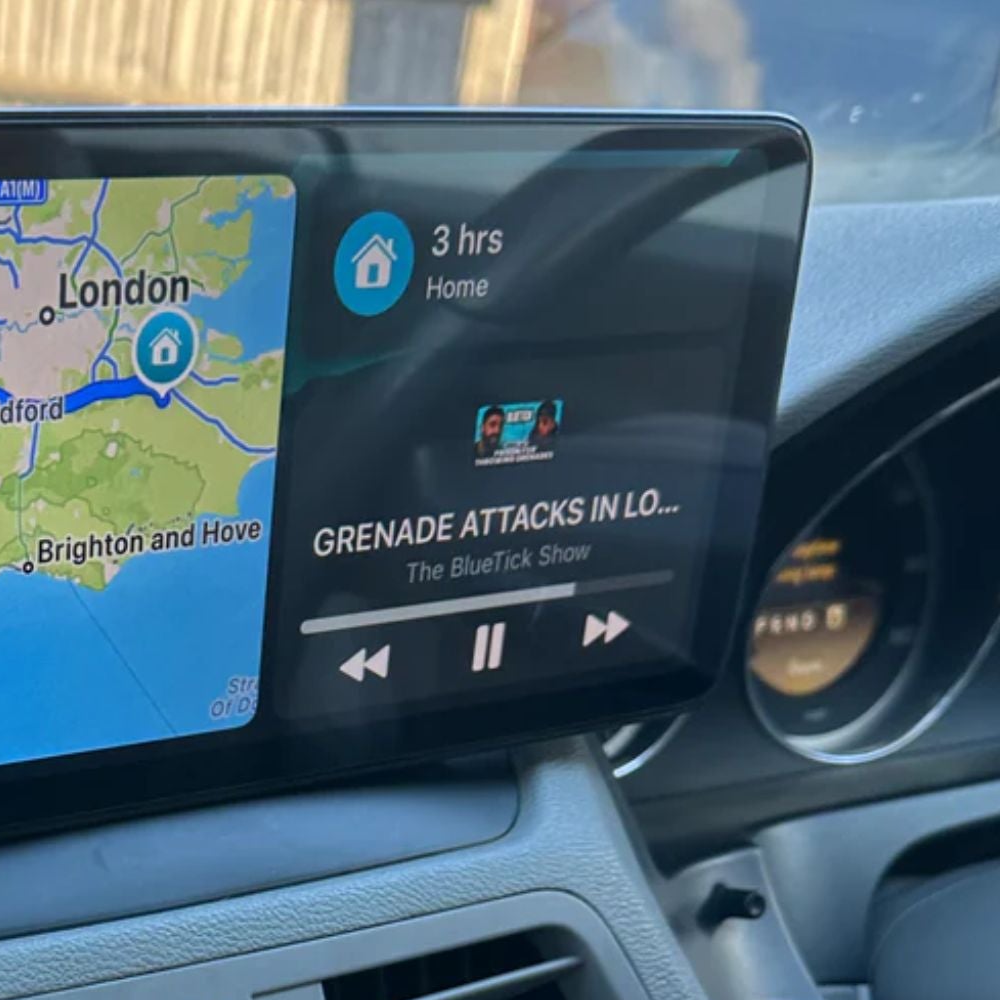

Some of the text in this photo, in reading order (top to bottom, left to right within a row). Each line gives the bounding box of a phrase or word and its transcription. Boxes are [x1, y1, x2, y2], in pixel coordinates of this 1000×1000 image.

[431, 223, 504, 256] 3 hrs
[58, 271, 190, 309] London
[425, 275, 489, 300] Home
[37, 518, 262, 566] Brighton and Hove
[313, 513, 453, 557] GRENADE
[459, 497, 584, 541] ATTACKS
[590, 494, 618, 523] IN
[407, 541, 593, 584] The BlueTick Show
[228, 677, 258, 695] Str
